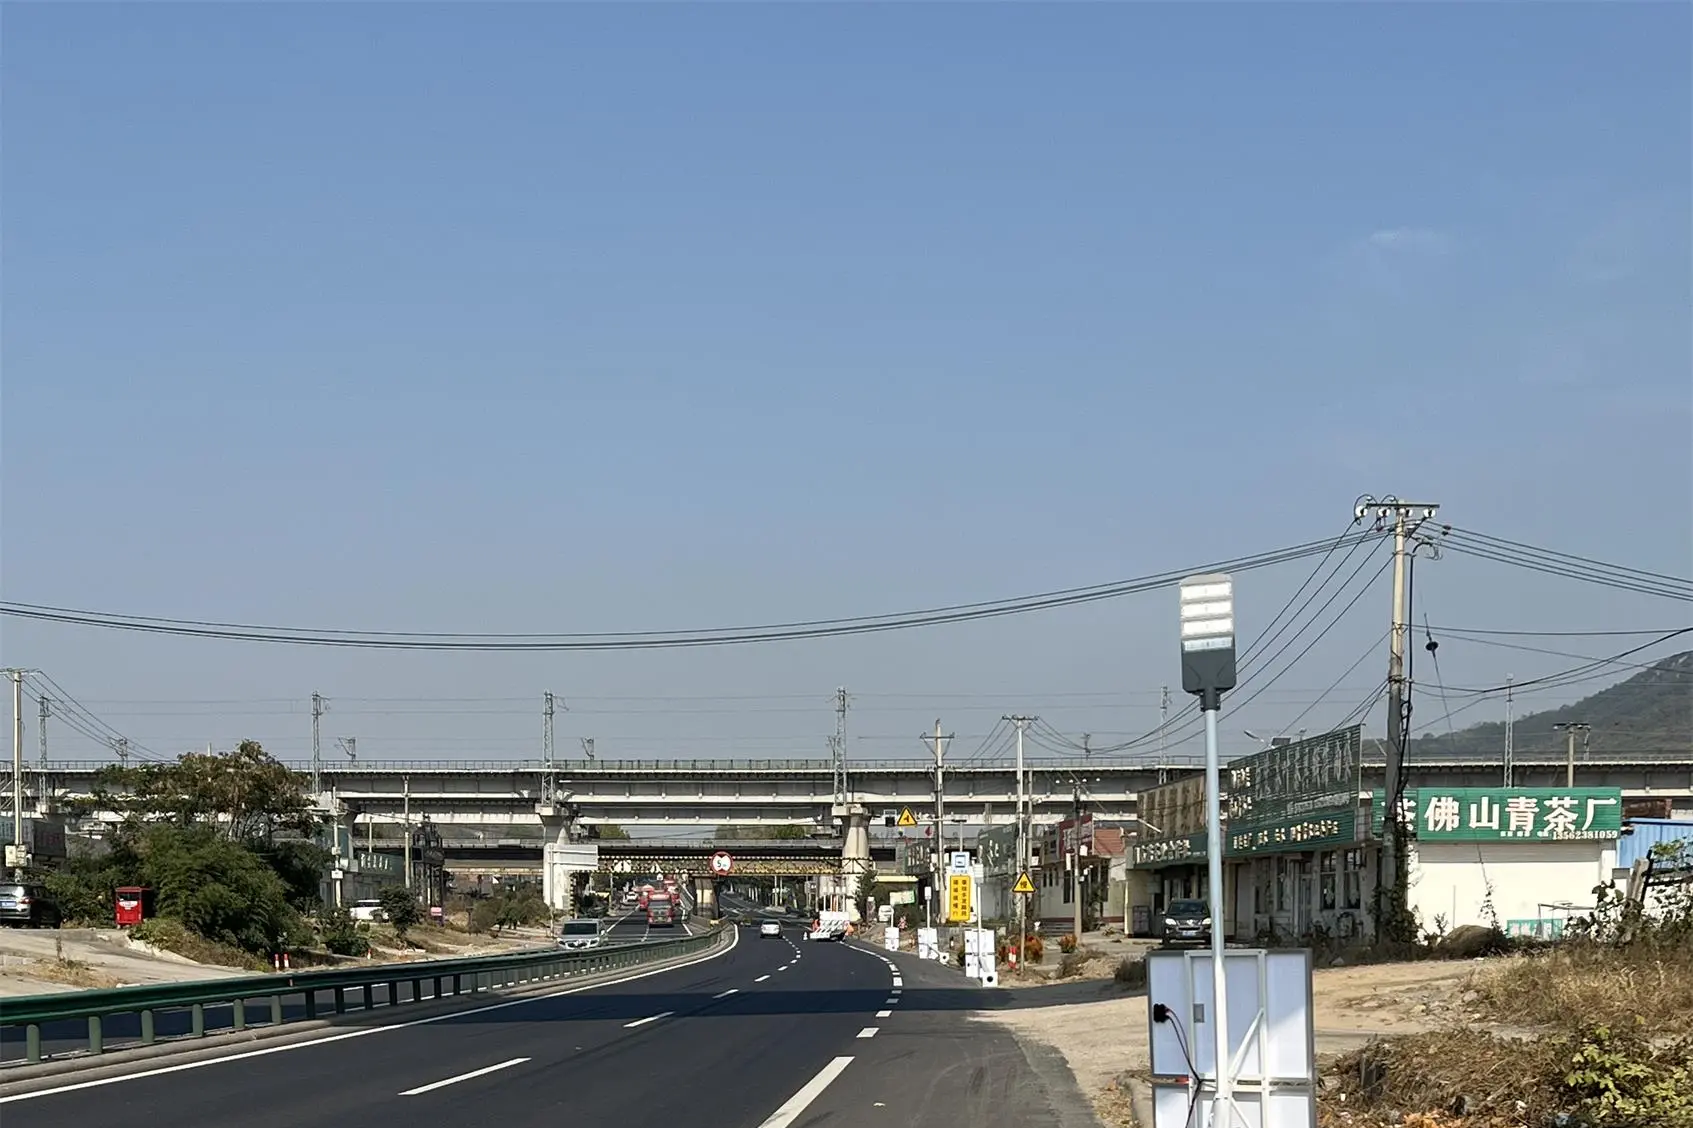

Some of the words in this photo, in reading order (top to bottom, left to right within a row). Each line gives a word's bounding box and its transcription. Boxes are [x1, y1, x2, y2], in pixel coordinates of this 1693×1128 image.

[1424, 797, 1617, 833] 佛山青茶厂
